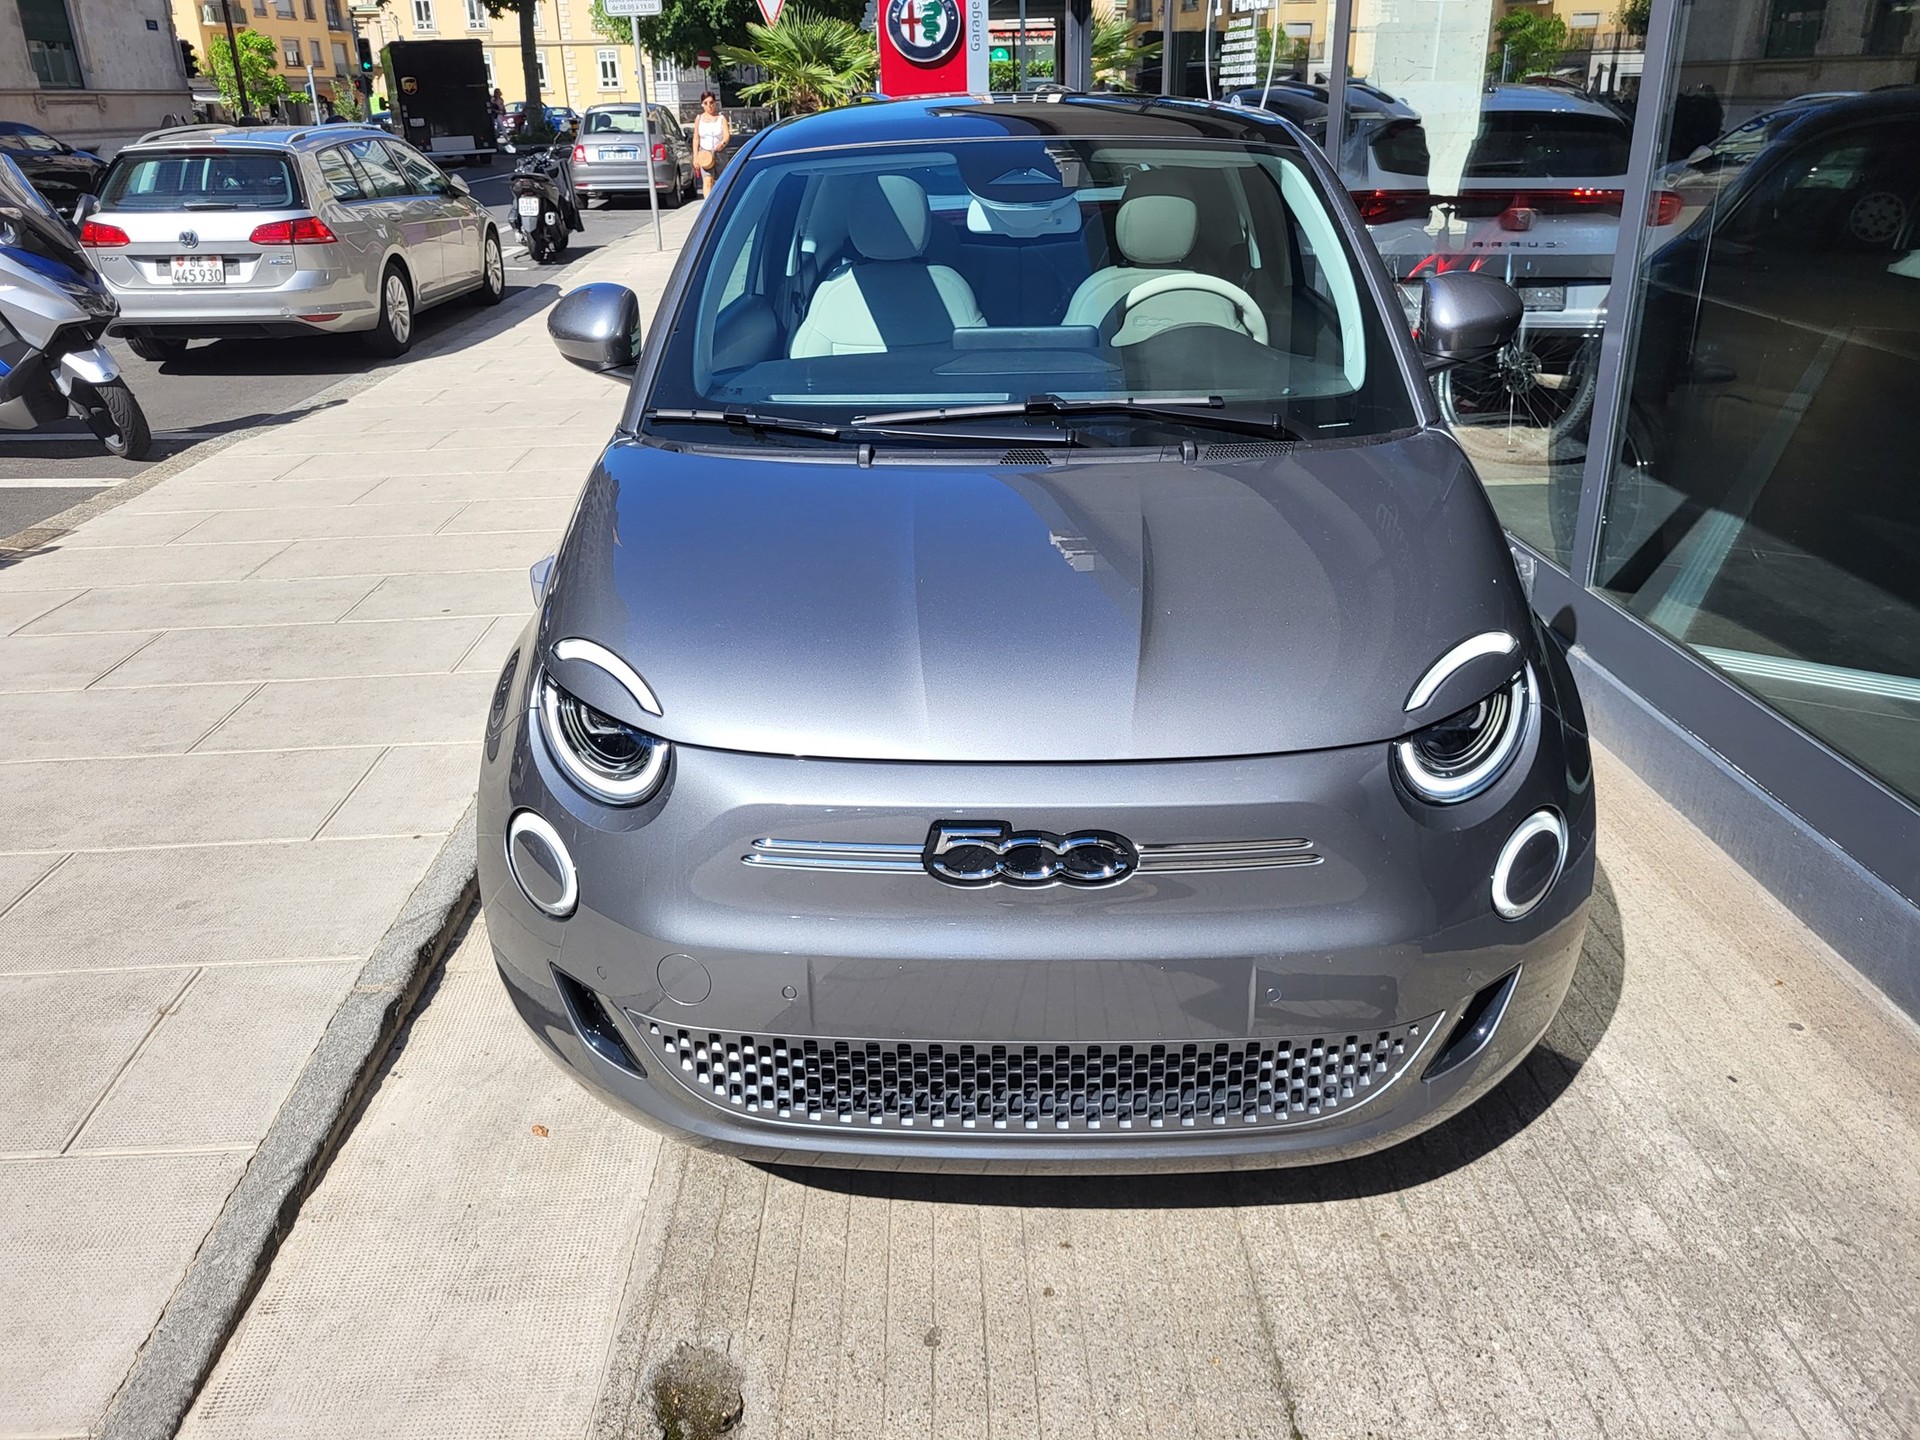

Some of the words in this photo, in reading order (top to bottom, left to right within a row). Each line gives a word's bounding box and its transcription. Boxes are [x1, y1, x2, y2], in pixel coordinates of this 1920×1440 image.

[970, 1, 983, 52] Garage
[189, 256, 204, 268] GE
[928, 823, 1135, 885] 500
